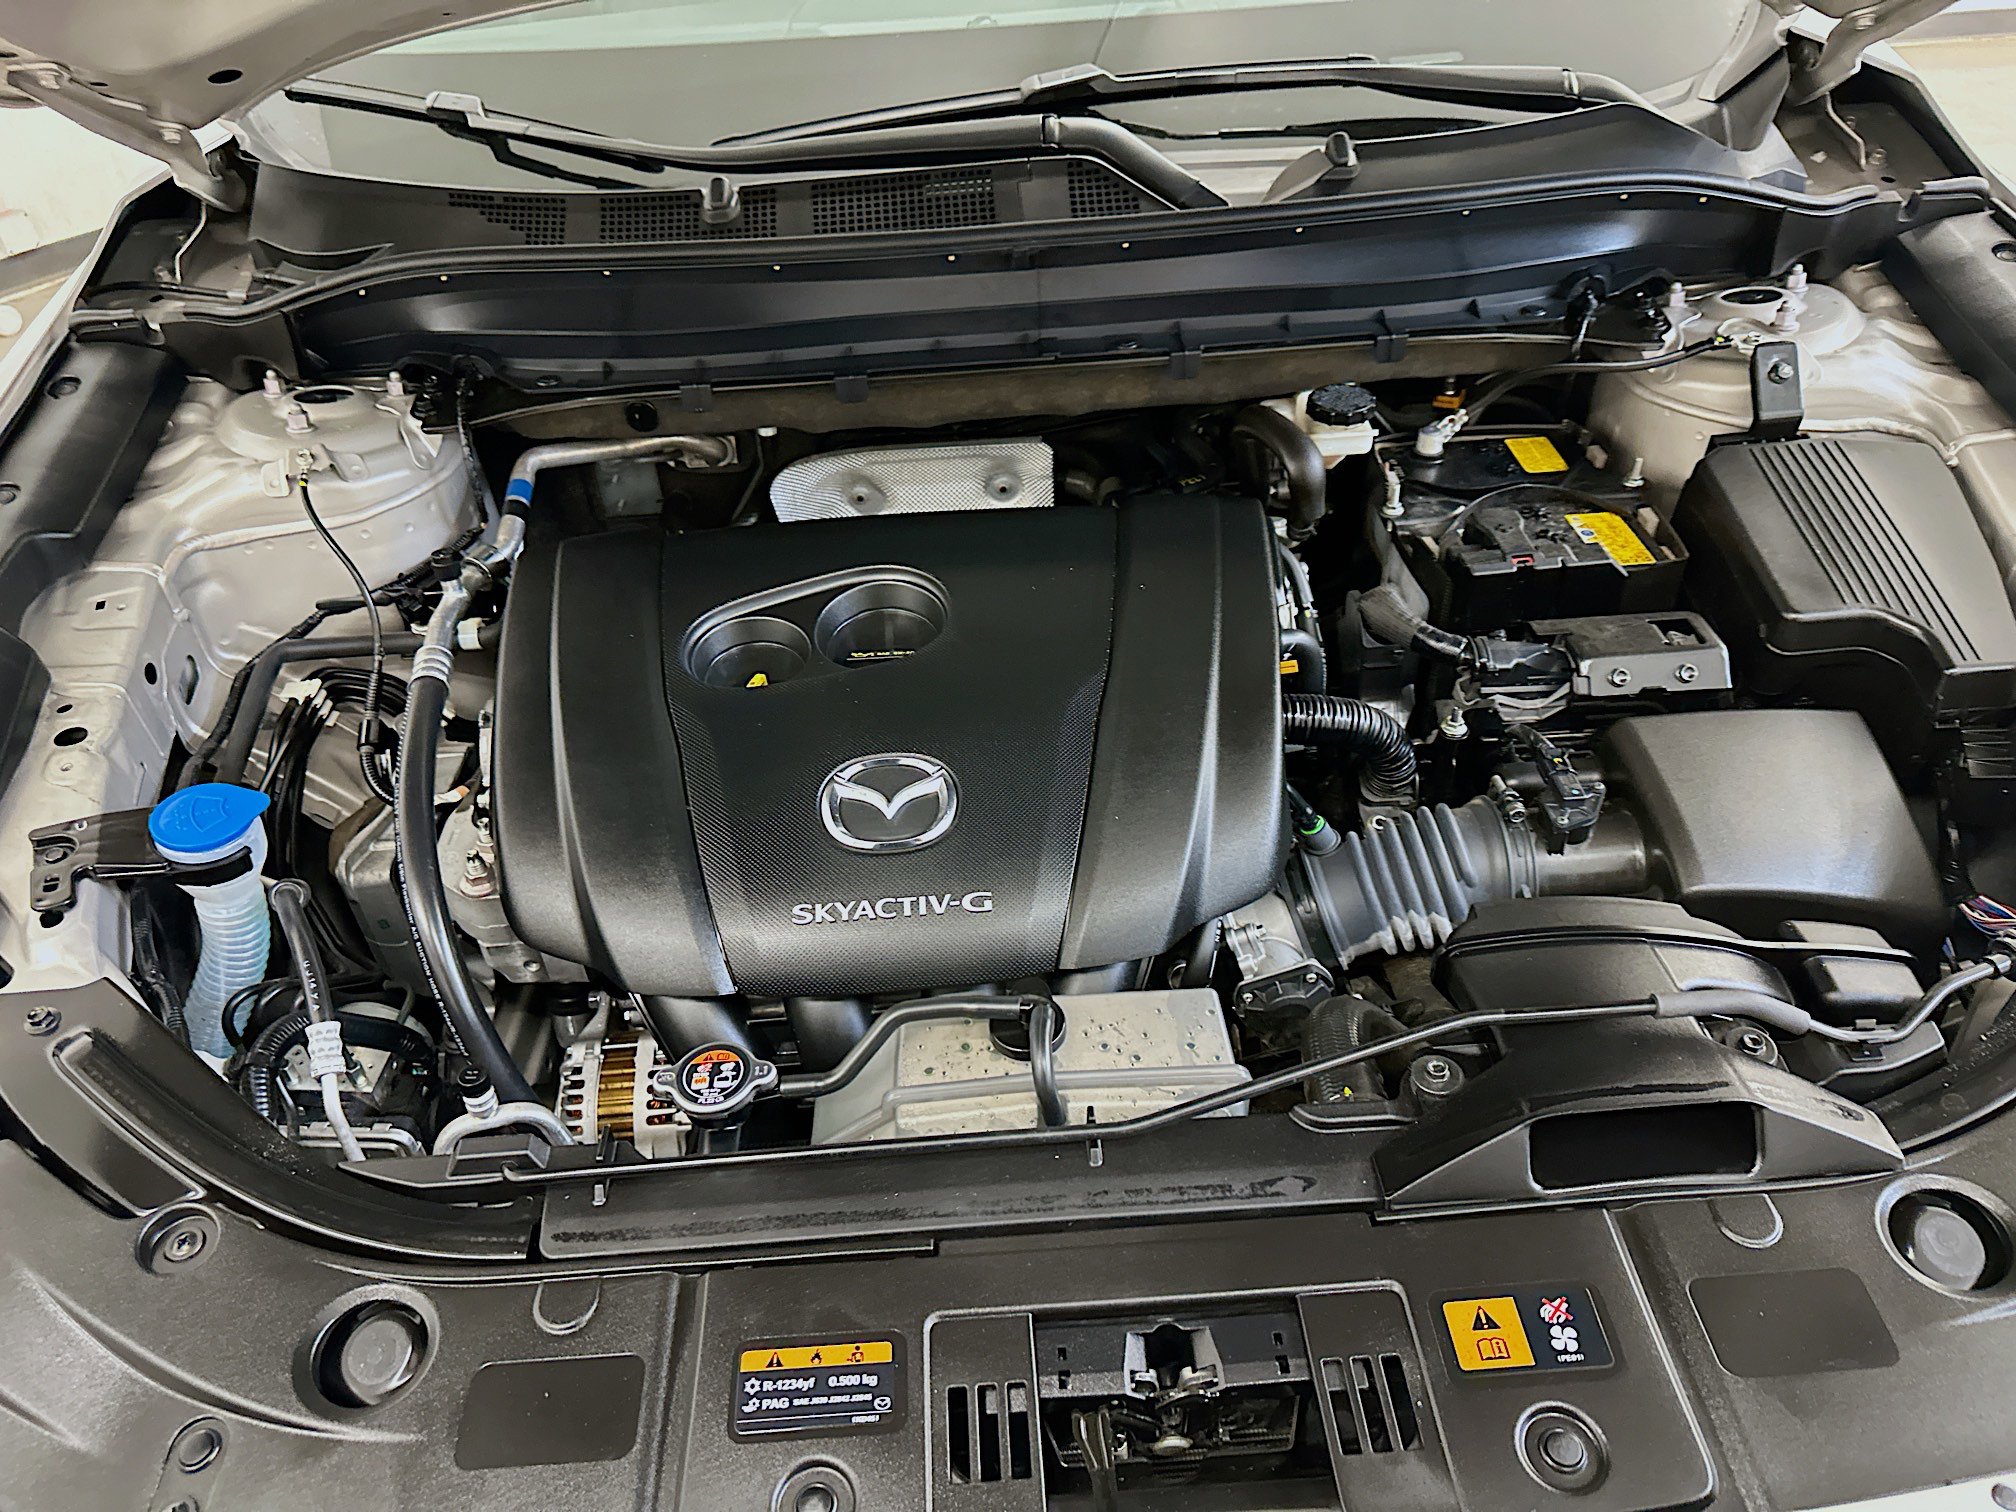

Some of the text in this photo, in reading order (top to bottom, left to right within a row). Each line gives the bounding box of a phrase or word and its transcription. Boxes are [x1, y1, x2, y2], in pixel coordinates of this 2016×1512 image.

[791, 891, 993, 925] SKYACTIV-G
[415, 941, 432, 977] SUCTION
[762, 1374, 878, 1391] R-1234yf 0.500 kg
[761, 1397, 790, 1410] PAG
